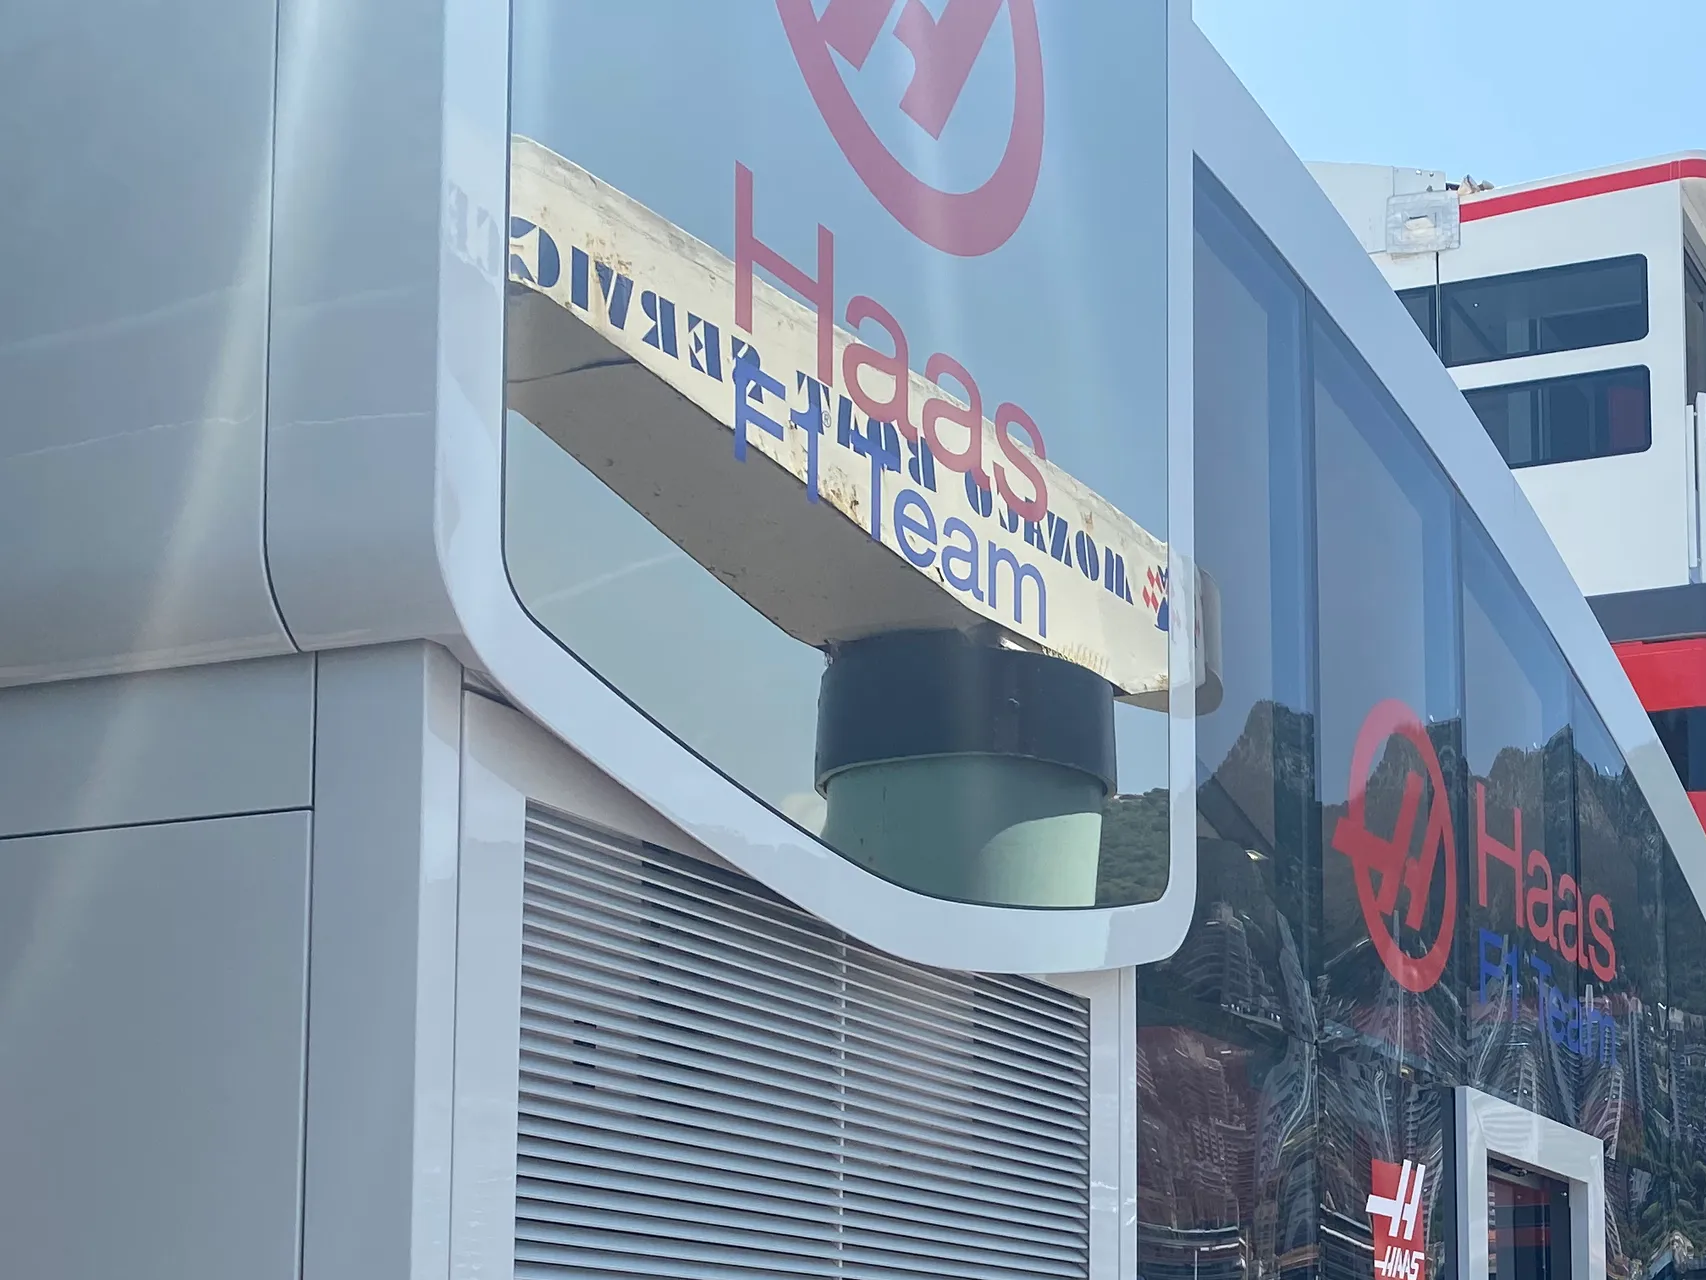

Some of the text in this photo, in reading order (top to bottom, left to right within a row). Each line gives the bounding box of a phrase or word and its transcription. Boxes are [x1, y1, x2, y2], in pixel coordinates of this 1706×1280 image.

[734, 160, 1047, 523] Haas
[734, 357, 1047, 639] F1 Team
[1476, 781, 1617, 982] Haas
[1479, 927, 1618, 1066] F1 Team
